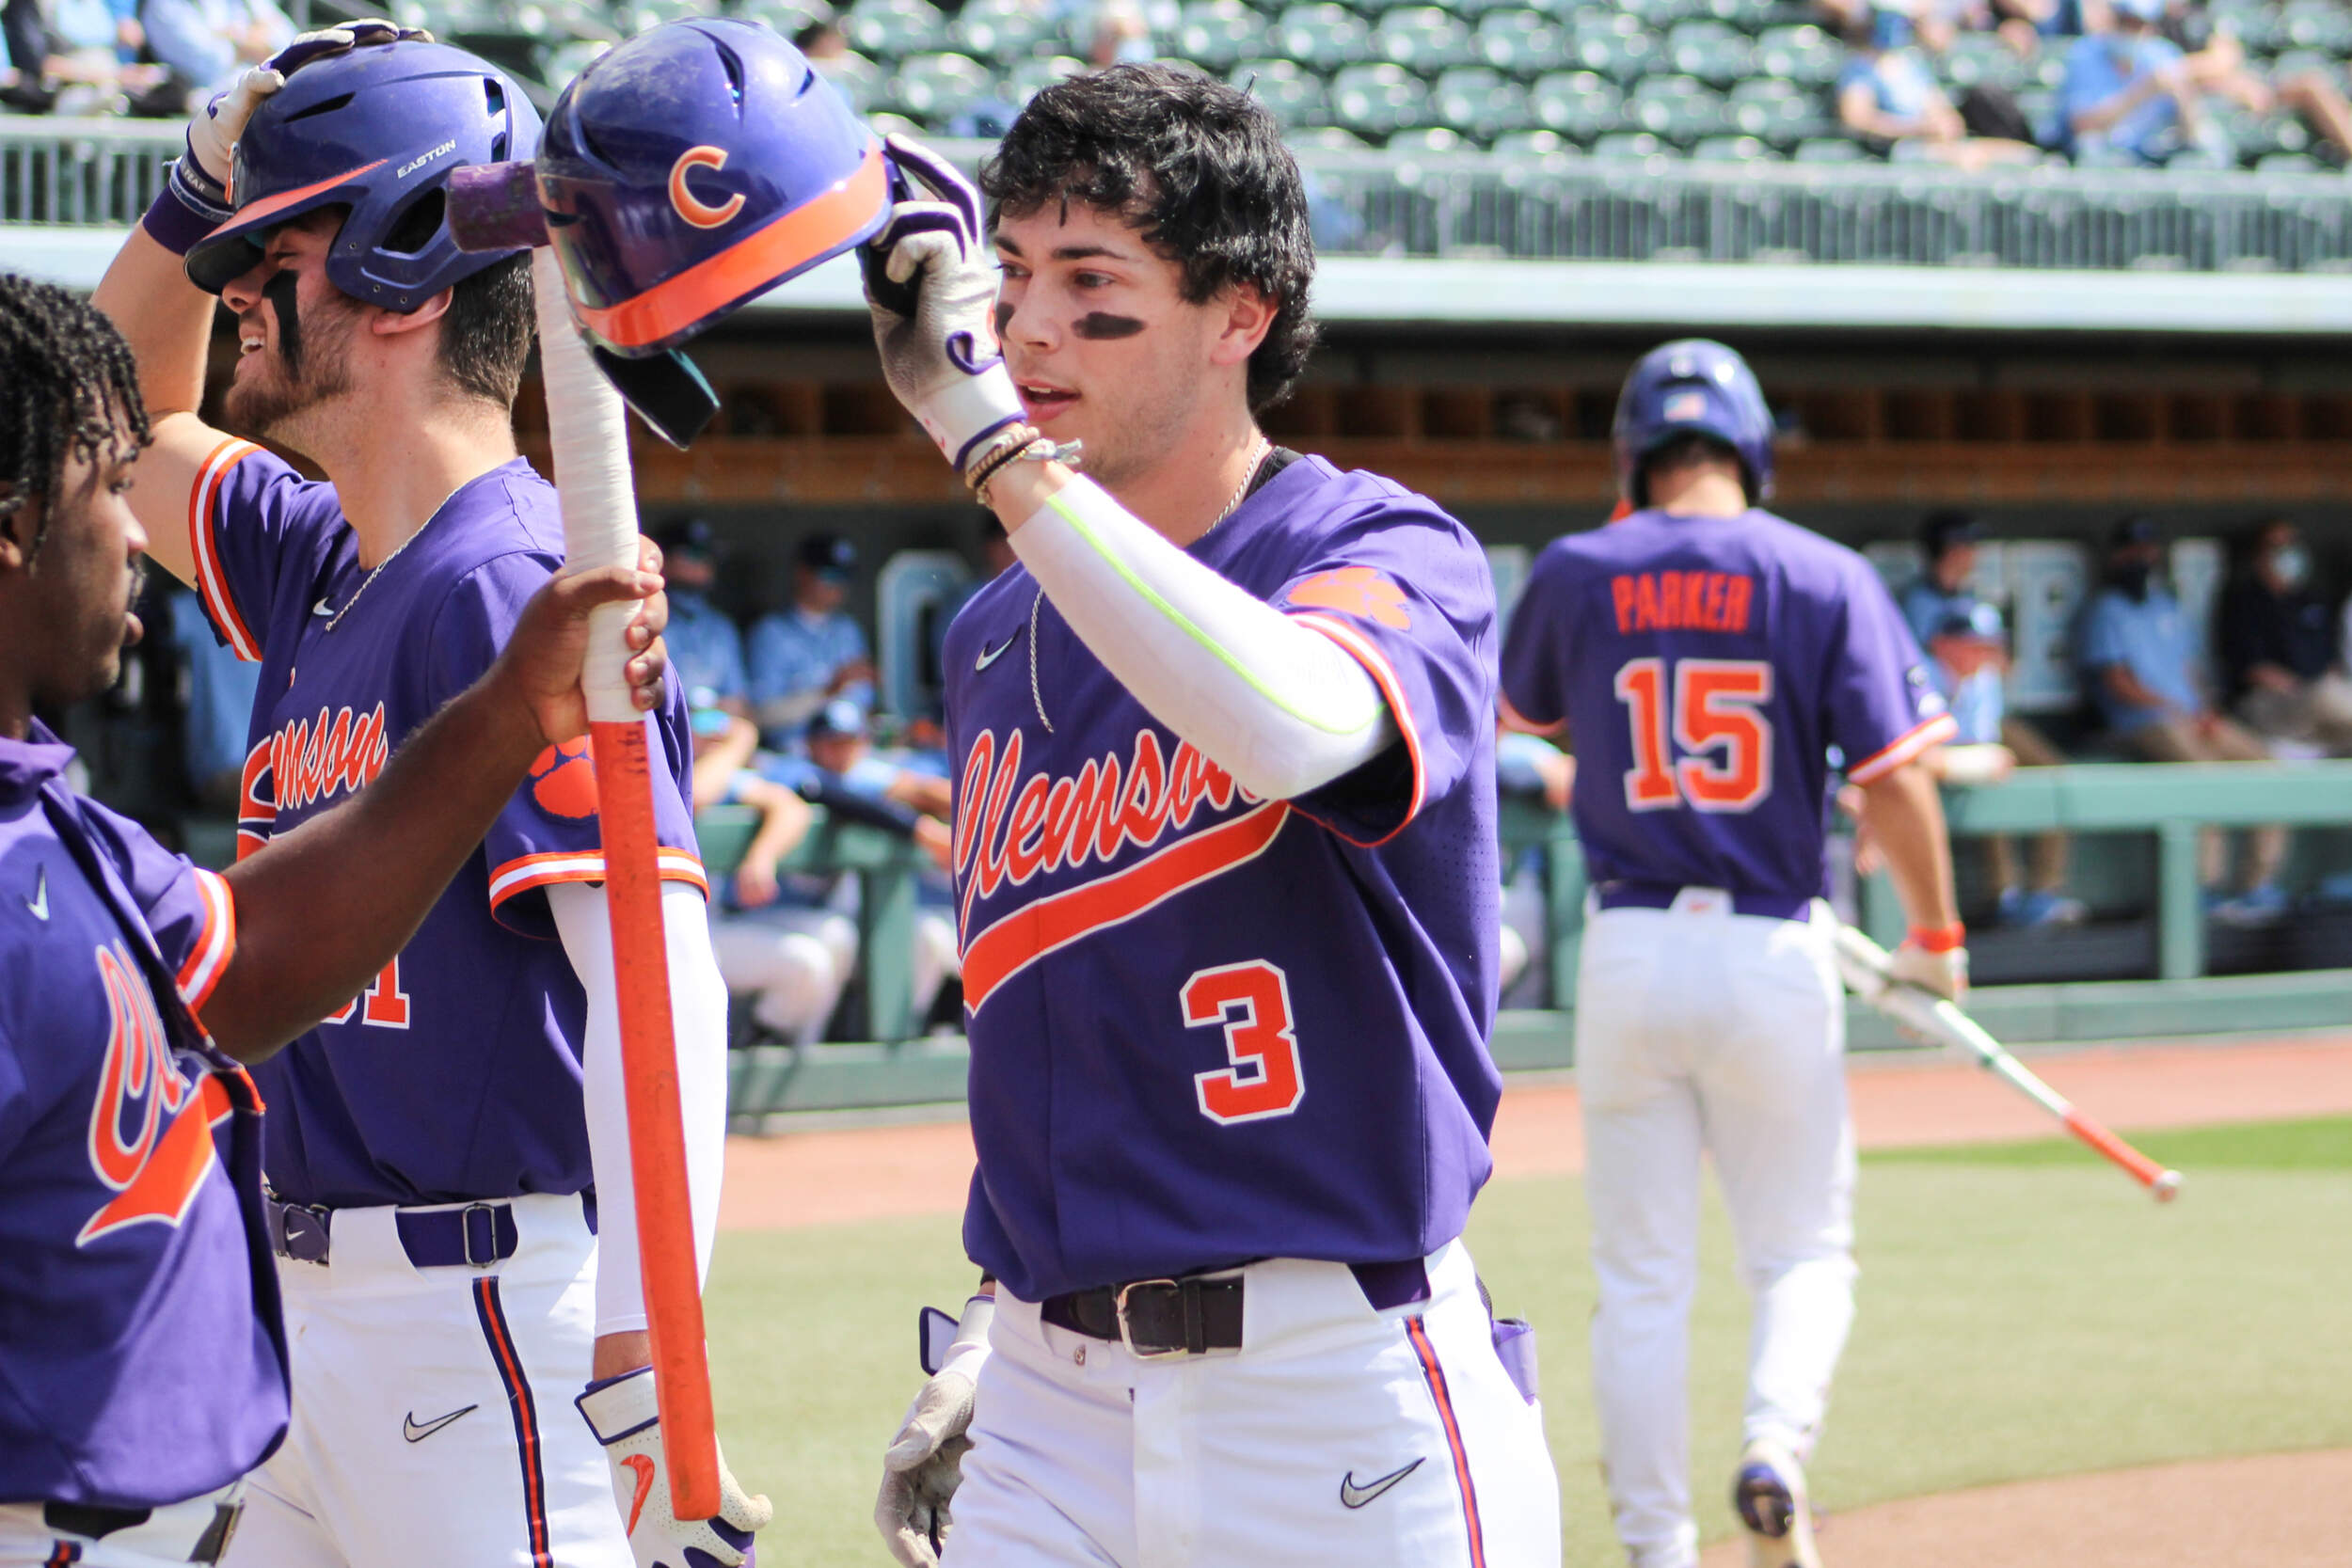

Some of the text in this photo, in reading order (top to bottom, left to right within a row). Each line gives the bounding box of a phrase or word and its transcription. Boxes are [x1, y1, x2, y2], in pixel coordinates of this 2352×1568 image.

[397, 138, 456, 179] EASTON
[668, 145, 747, 230] C
[1611, 570, 1755, 636] PARKER
[1613, 657, 1774, 815] 15
[1179, 958, 1306, 1126] 3
